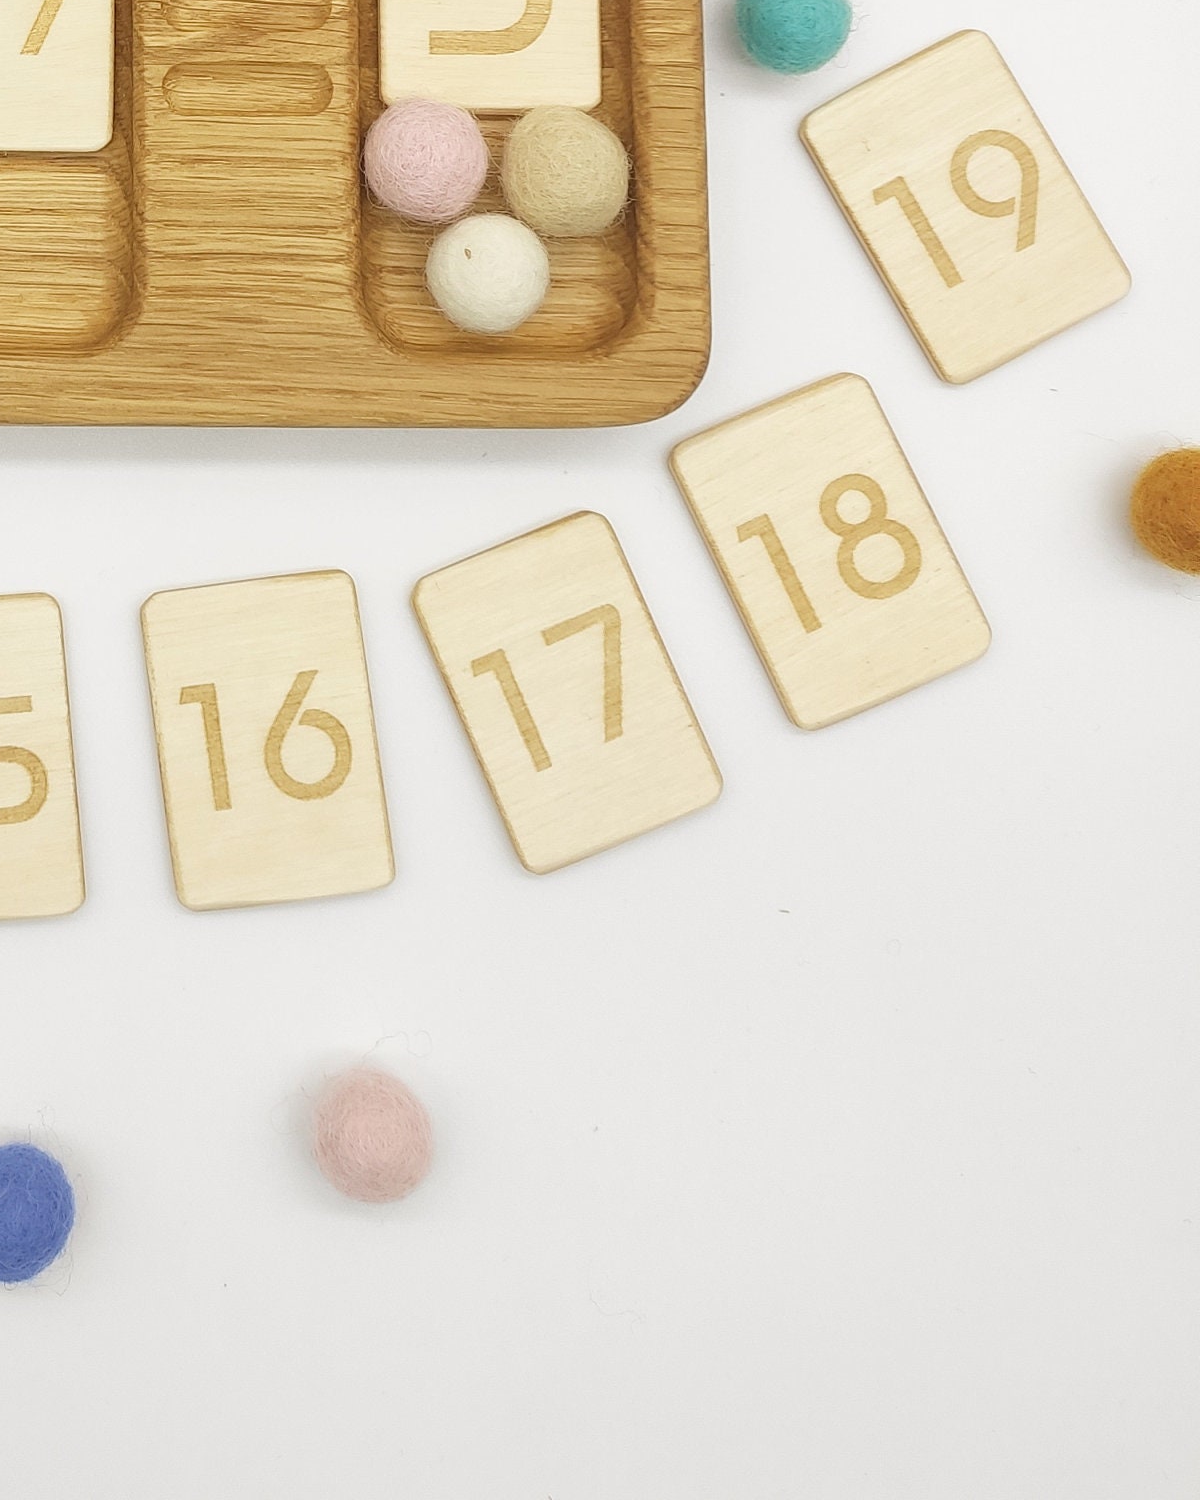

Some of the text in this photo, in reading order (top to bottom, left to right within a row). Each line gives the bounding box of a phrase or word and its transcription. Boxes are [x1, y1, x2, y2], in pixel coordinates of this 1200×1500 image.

[872, 131, 1040, 290] 19
[736, 474, 923, 636] 18
[180, 671, 353, 811] 16
[468, 605, 624, 773] 17
